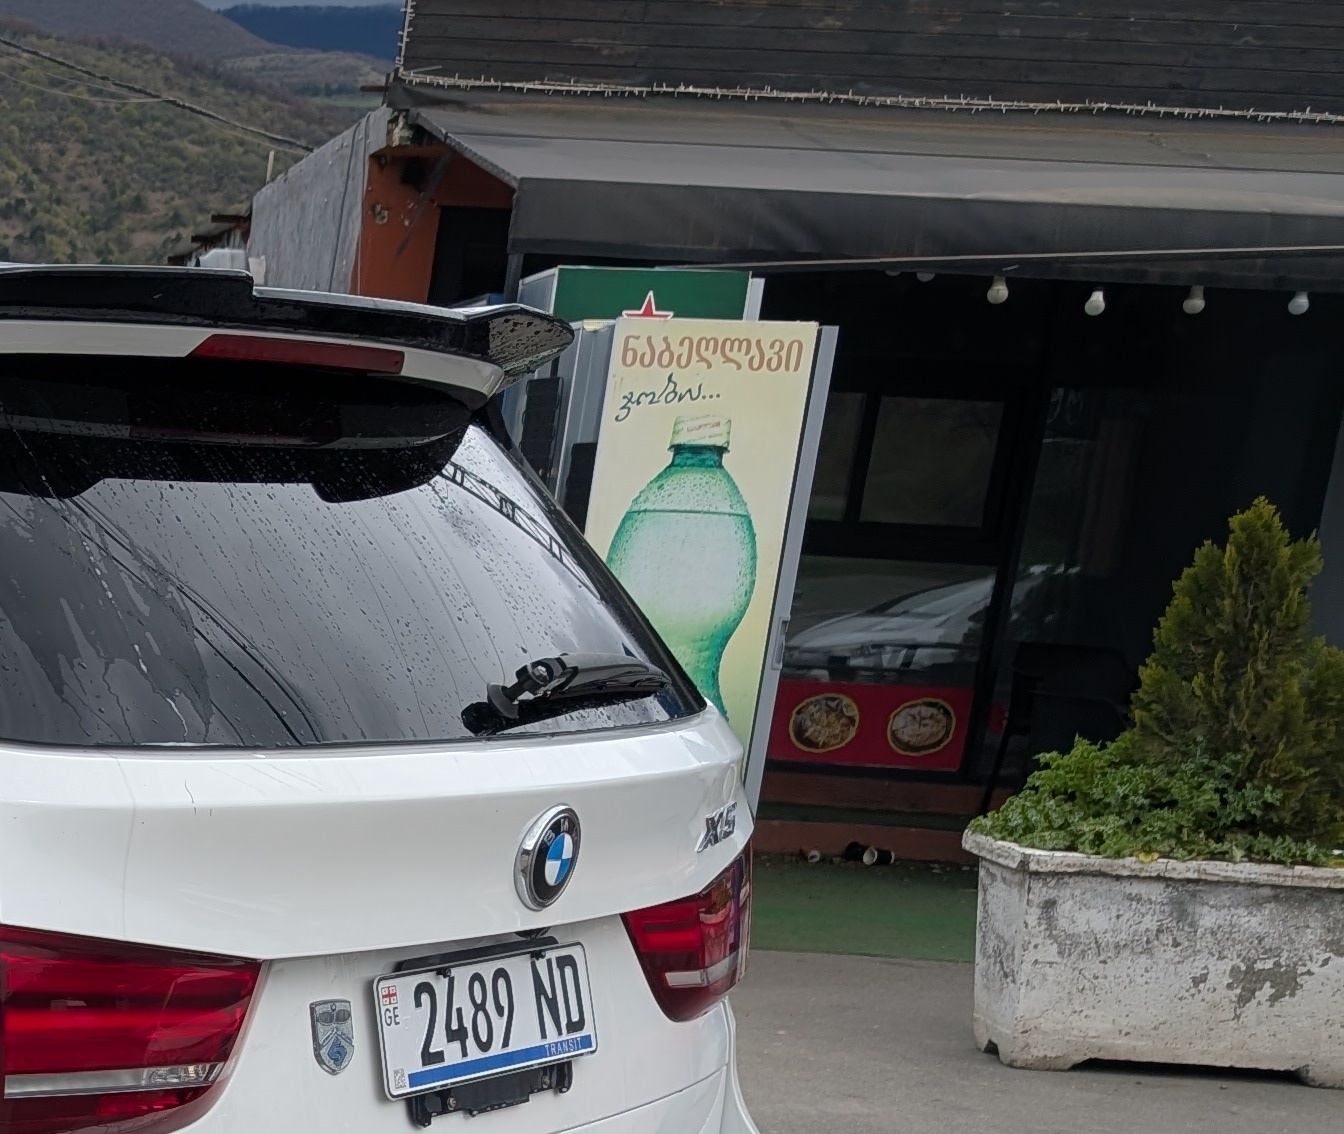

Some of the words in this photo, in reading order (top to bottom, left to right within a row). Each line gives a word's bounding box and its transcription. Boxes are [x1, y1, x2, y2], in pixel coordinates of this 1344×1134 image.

[621, 335, 804, 372] ნაბეღლავი
[695, 801, 737, 854] X5
[384, 1006, 401, 1027] GE
[414, 967, 515, 1067] 2489
[531, 954, 586, 1040] ND
[544, 1037, 582, 1057] TRANSIT
